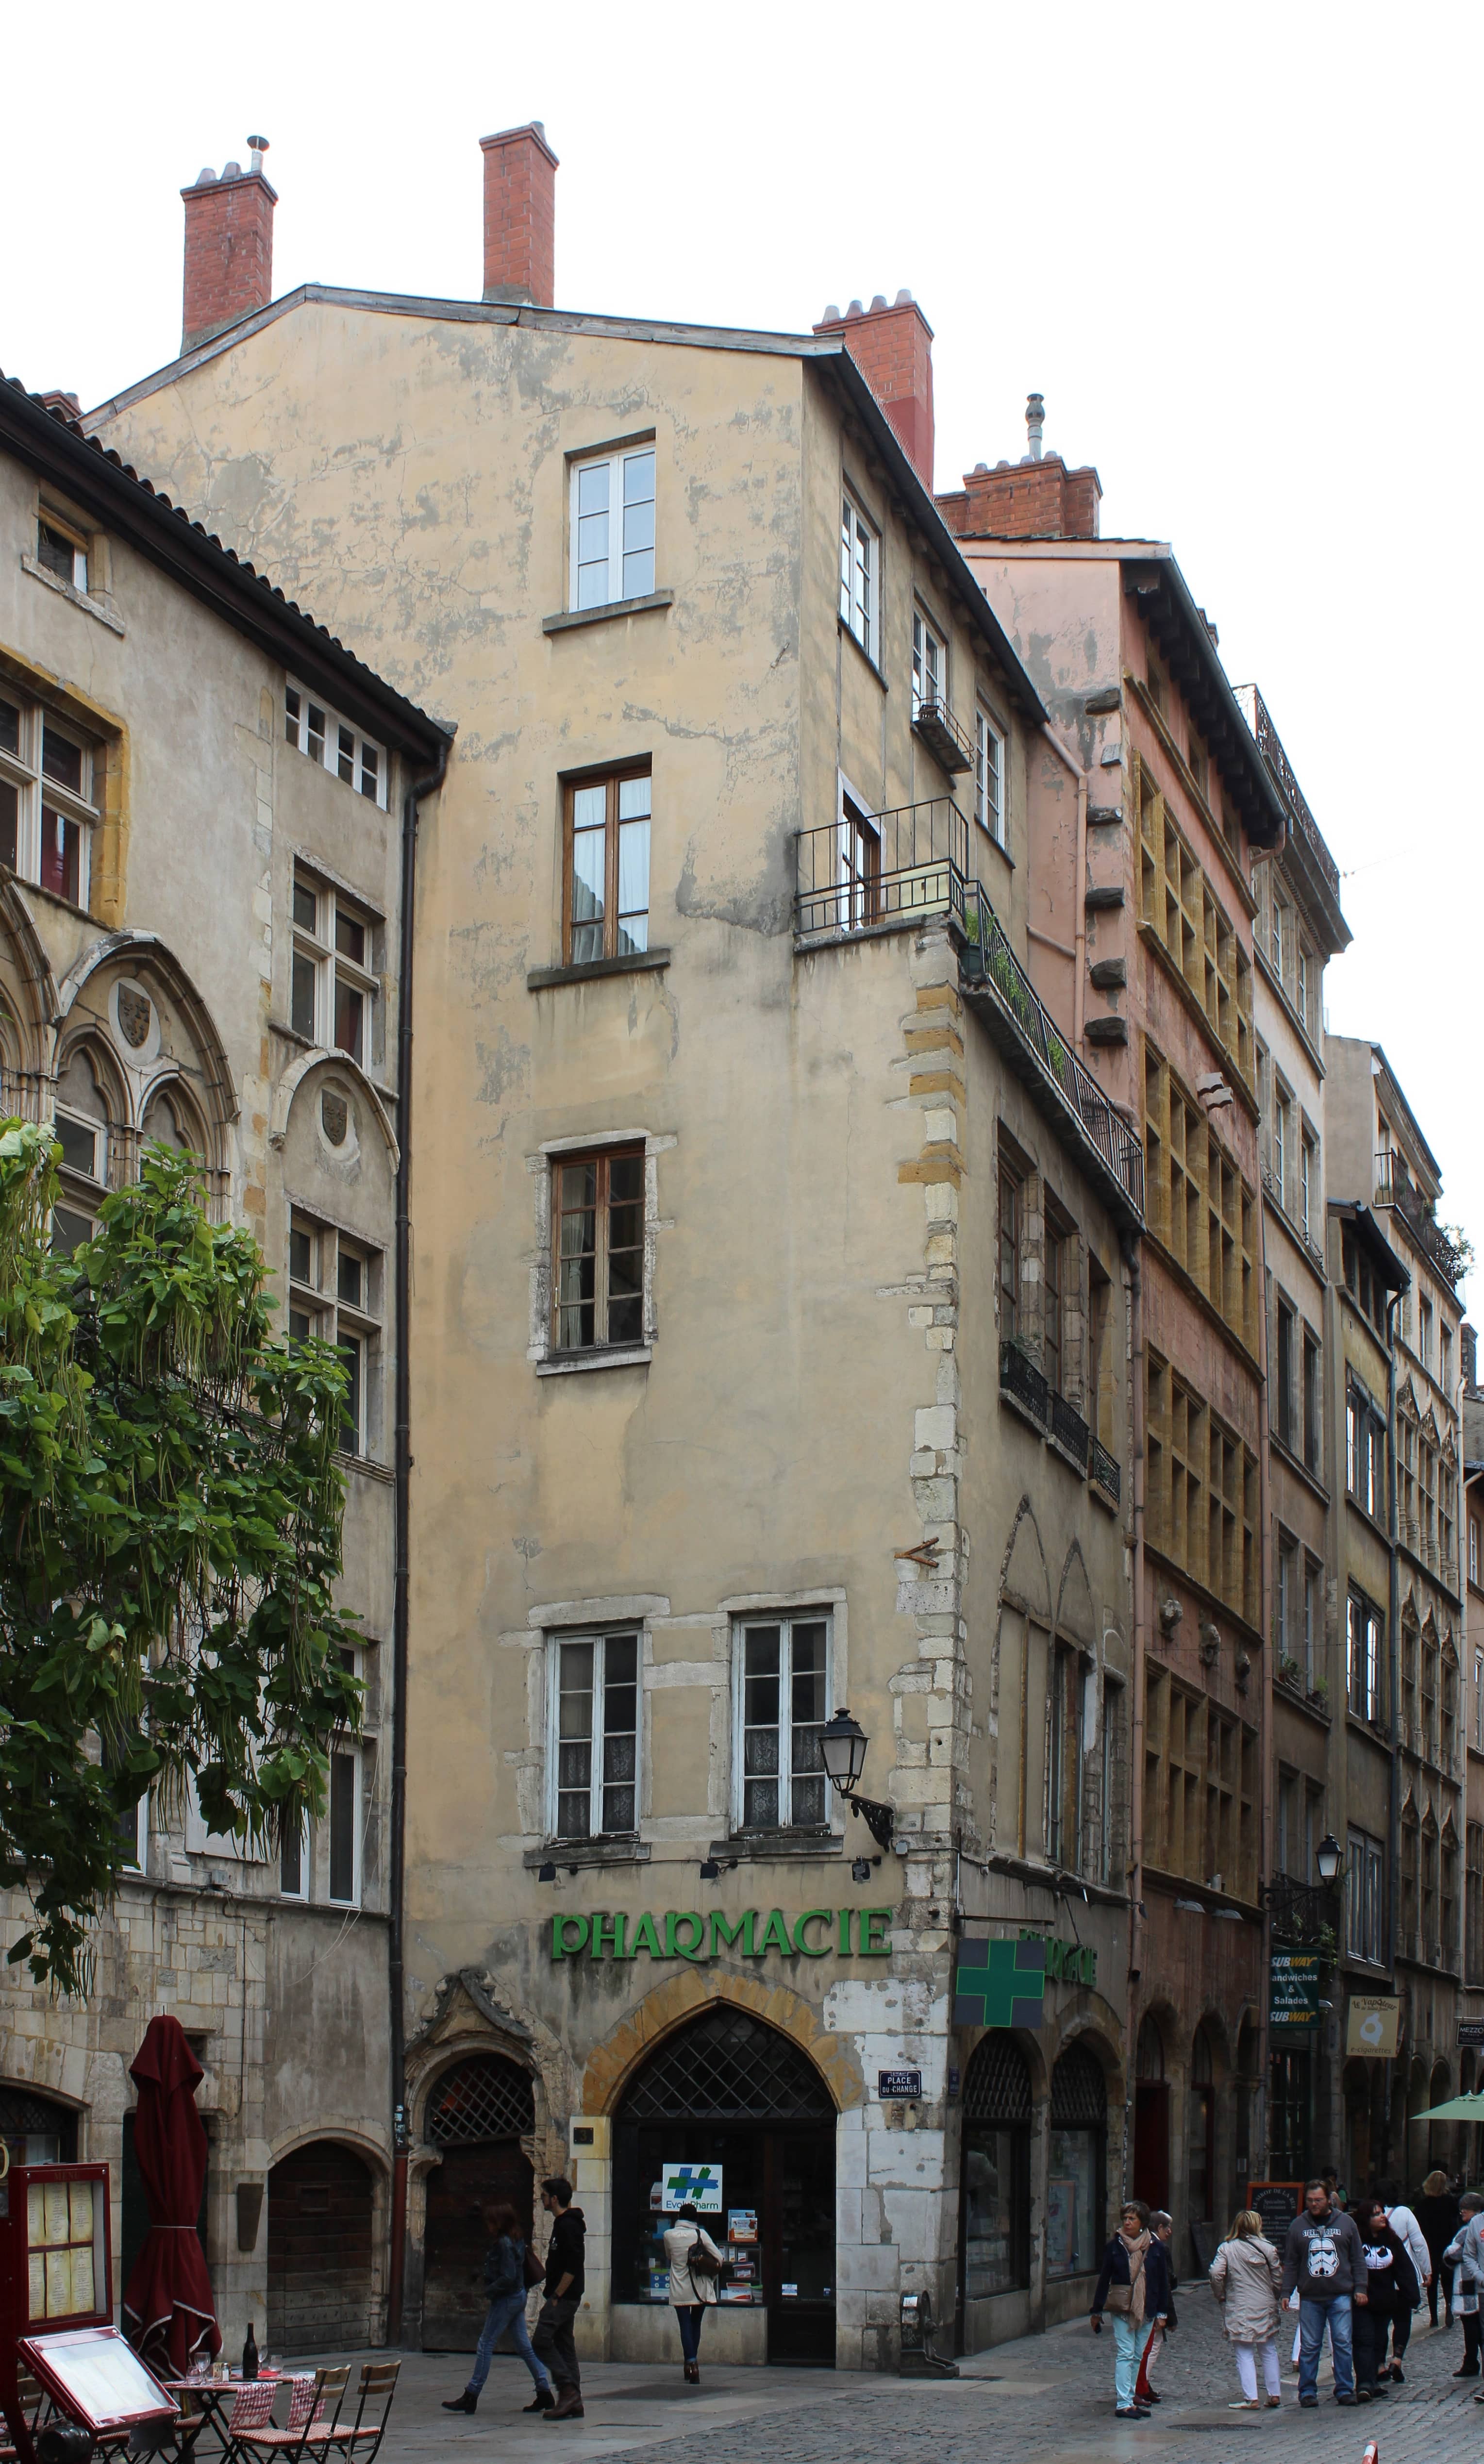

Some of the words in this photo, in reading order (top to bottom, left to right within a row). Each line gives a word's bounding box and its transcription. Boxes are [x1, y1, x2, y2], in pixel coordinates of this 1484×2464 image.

[551, 1909, 893, 1961] PHARMACIE
[1271, 1957, 1317, 1967] SUBWAY
[1288, 1984, 1295, 1993] &
[1270, 2011, 1317, 2022] SUBWAY
